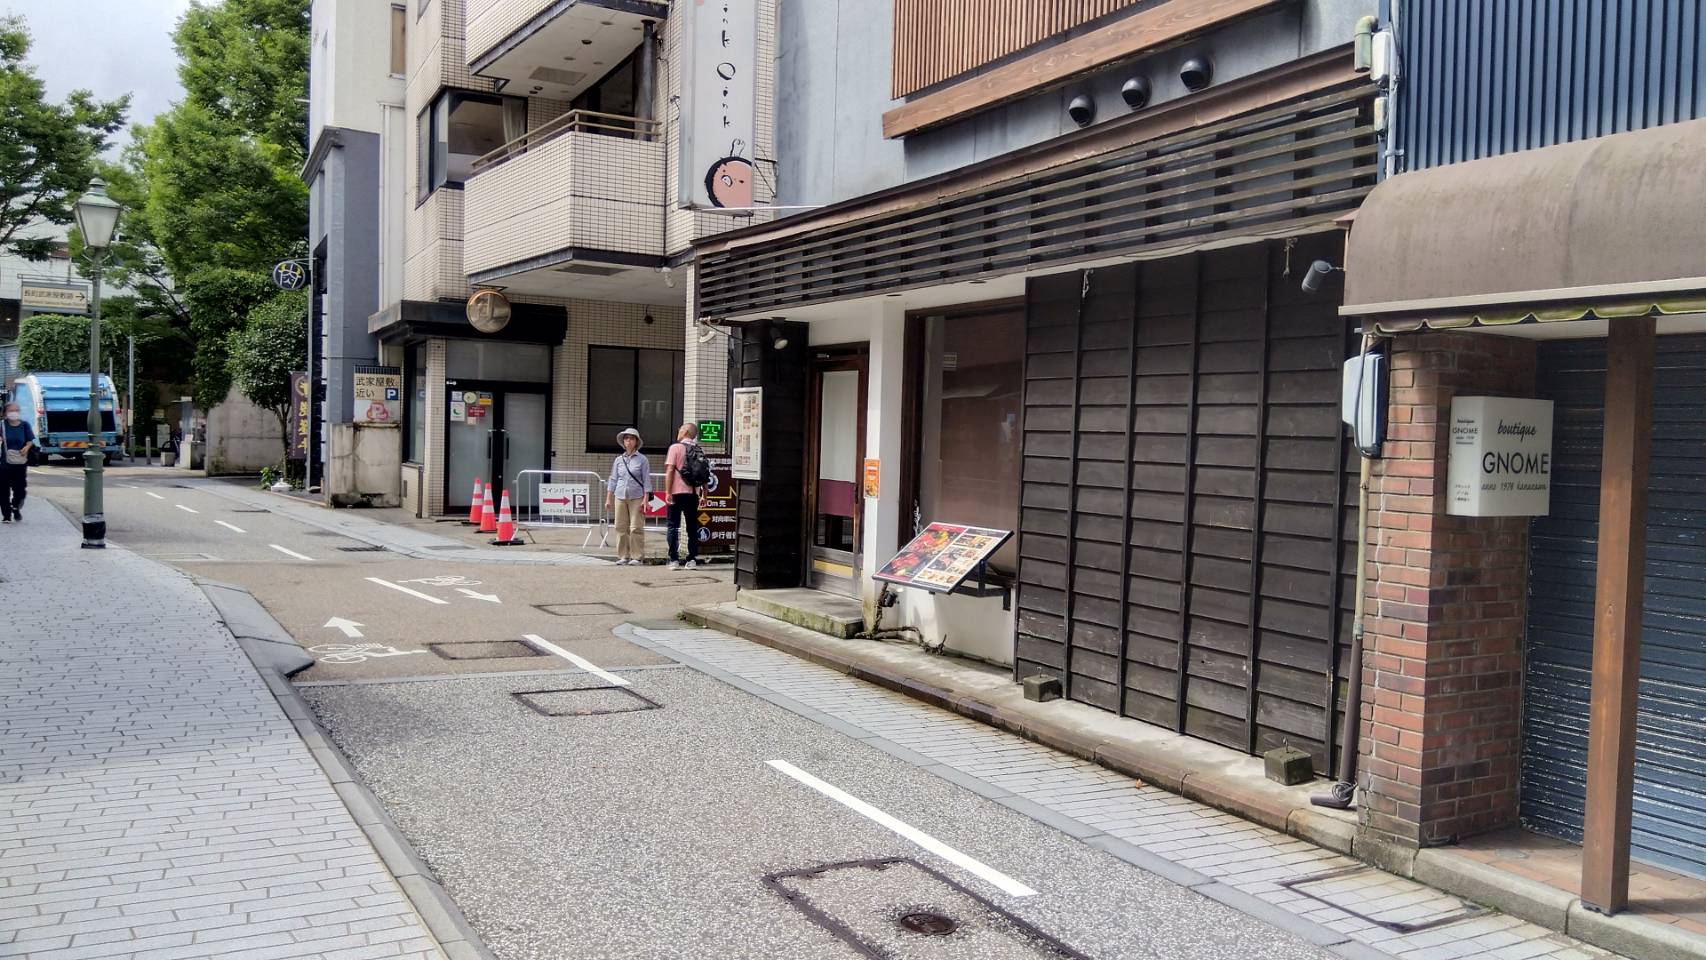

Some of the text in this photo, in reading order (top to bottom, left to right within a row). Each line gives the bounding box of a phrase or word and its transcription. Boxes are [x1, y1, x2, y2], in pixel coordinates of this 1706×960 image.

[716, 61, 737, 129] Oink
[355, 388, 375, 398] 近い
[700, 421, 721, 442] 空
[1497, 419, 1537, 442] boutique
[1482, 451, 1549, 475] GNOME
